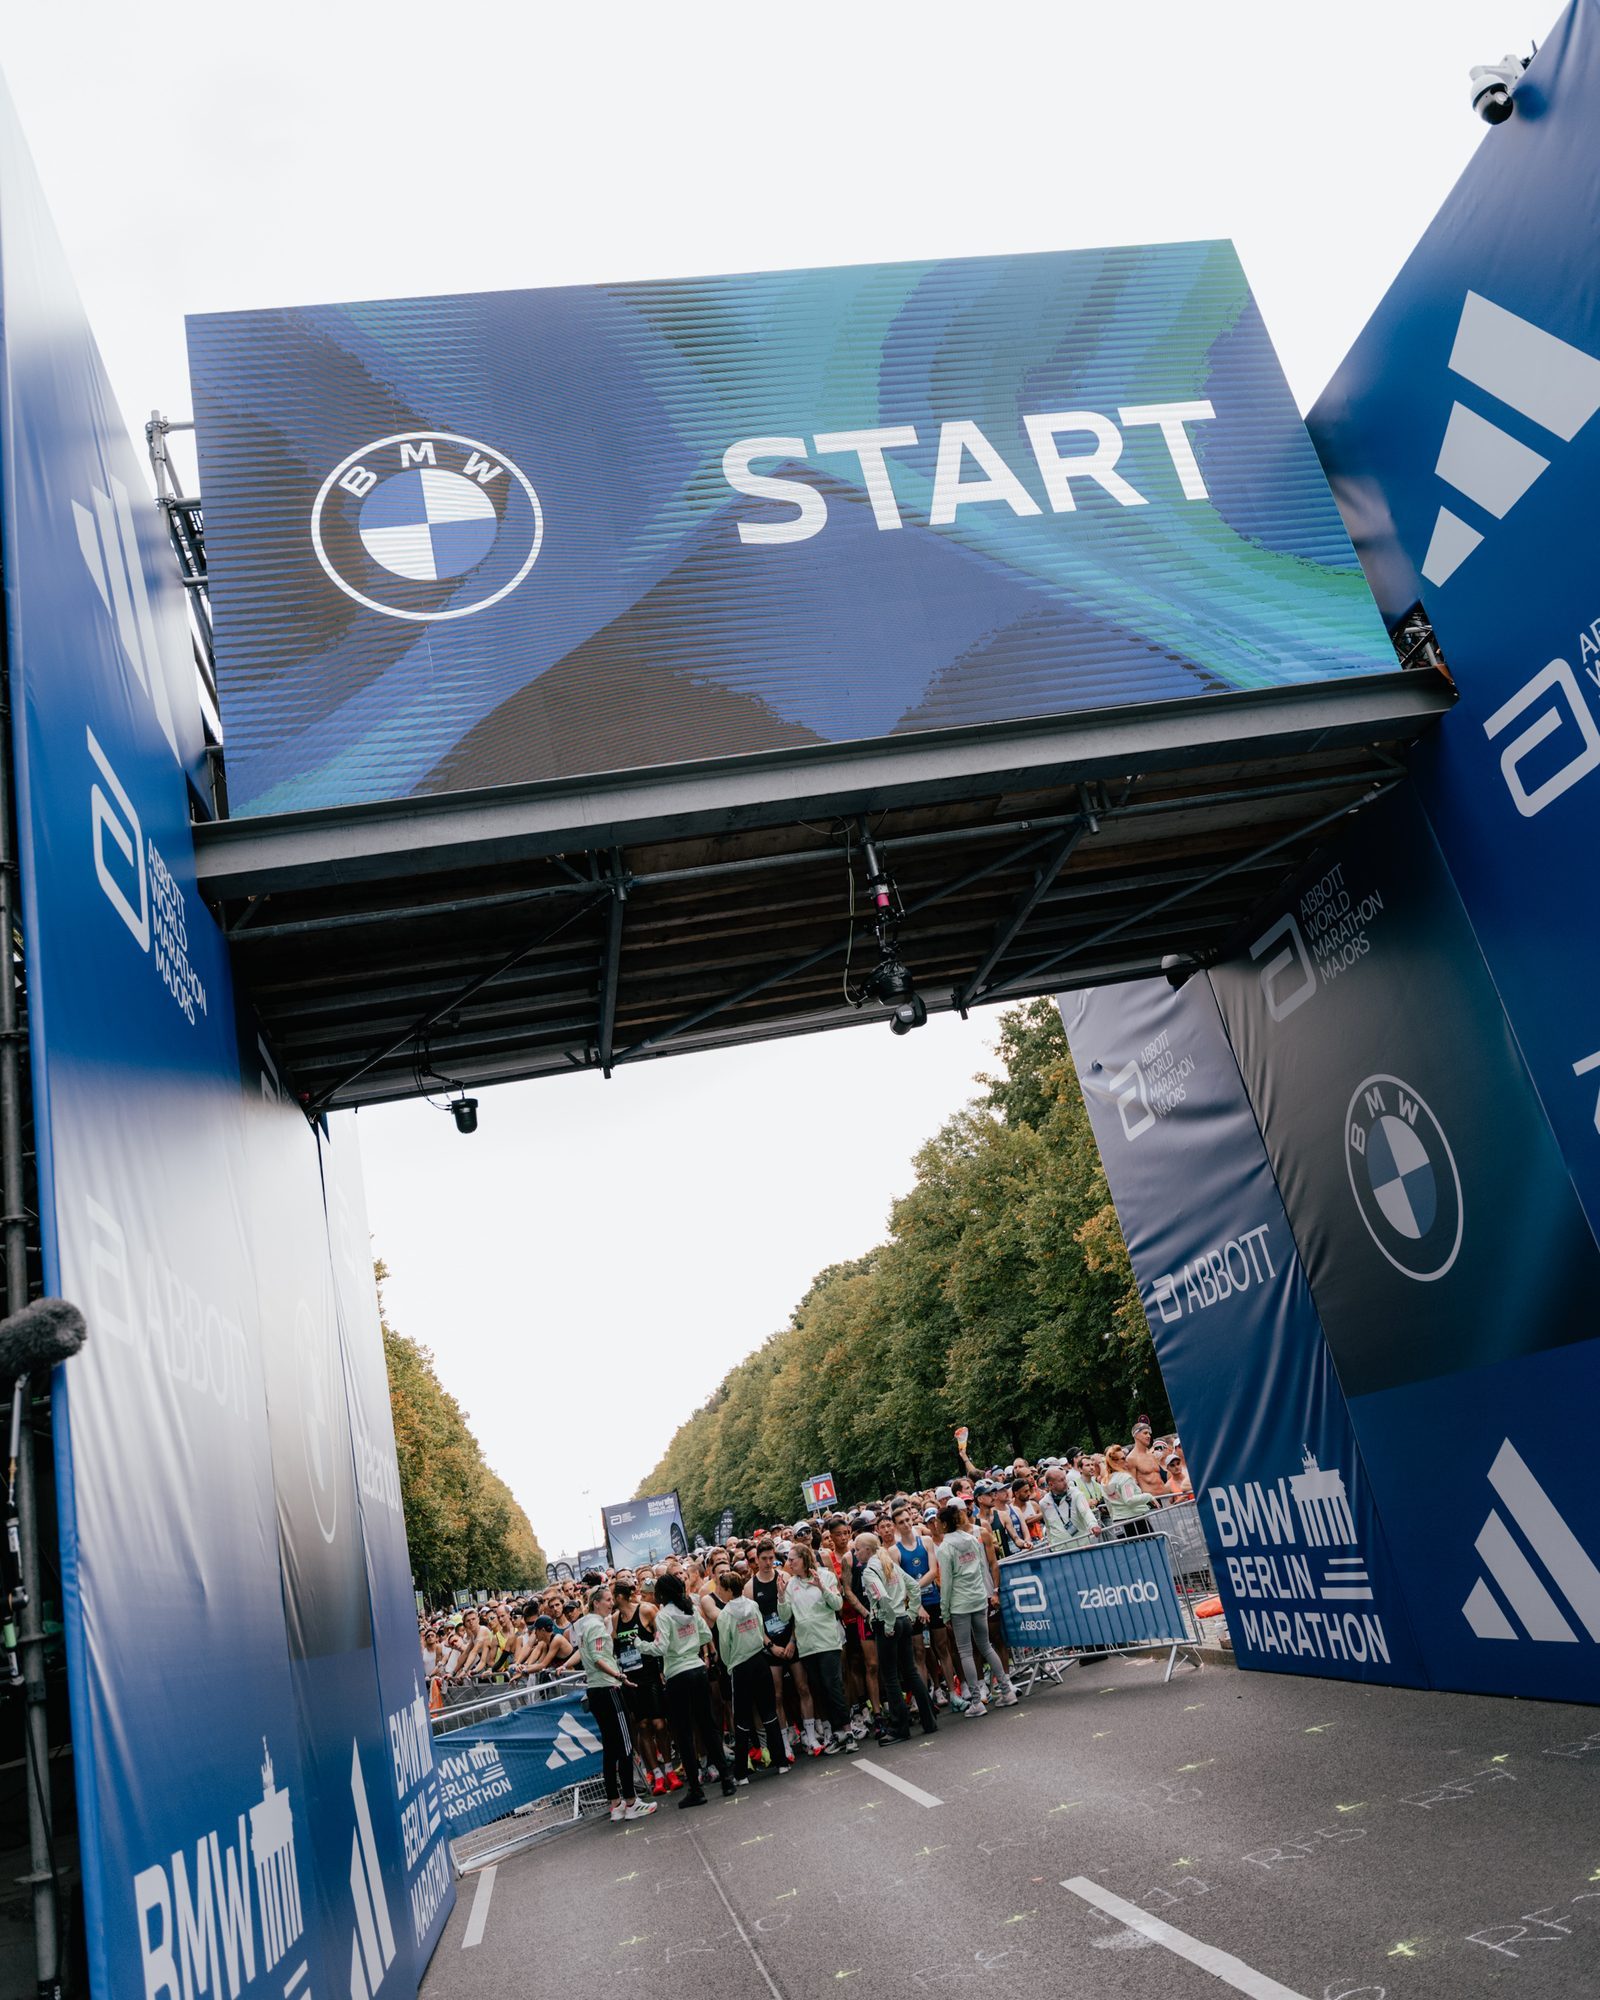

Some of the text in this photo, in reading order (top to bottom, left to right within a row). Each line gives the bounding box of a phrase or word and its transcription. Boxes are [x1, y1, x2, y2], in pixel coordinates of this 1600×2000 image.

[338, 441, 504, 498] BMW
[721, 399, 1217, 545] START
[148, 837, 186, 924] ABBOTT
[149, 867, 188, 953] WORLD
[1300, 862, 1345, 921] ABBOTT
[1304, 889, 1351, 941] WORLD
[1312, 888, 1384, 964] MARATHON
[152, 904, 207, 1017] MARATHON
[154, 939, 196, 1027] MAJORS
[1319, 930, 1371, 985] MAJORS
[1140, 1028, 1169, 1068] ABBOTT
[1144, 1050, 1174, 1085] WORLD
[1149, 1053, 1196, 1103] MARATHON
[1153, 1082, 1187, 1119] MAJORS
[1350, 1086, 1420, 1156] BMW
[1183, 1223, 1276, 1314] ABBOTT
[144, 1252, 249, 1422] ABBOTT
[819, 1481, 832, 1500] A
[1207, 1477, 1296, 1548] BMW
[1077, 1578, 1160, 1610] zalando
[1226, 1554, 1317, 1600] BERLIN
[1019, 1618, 1051, 1632] ABBOTT
[1239, 1609, 1392, 1665] MARATHON
[389, 1702, 422, 1801] BMW
[437, 1751, 470, 1780] MW
[439, 1772, 479, 1803] ERLIN
[400, 1788, 431, 1872] BERLIN
[134, 1813, 256, 2000] BMW
[410, 1835, 451, 1949] MARATHON
[1464, 1892, 1600, 1958] RF
